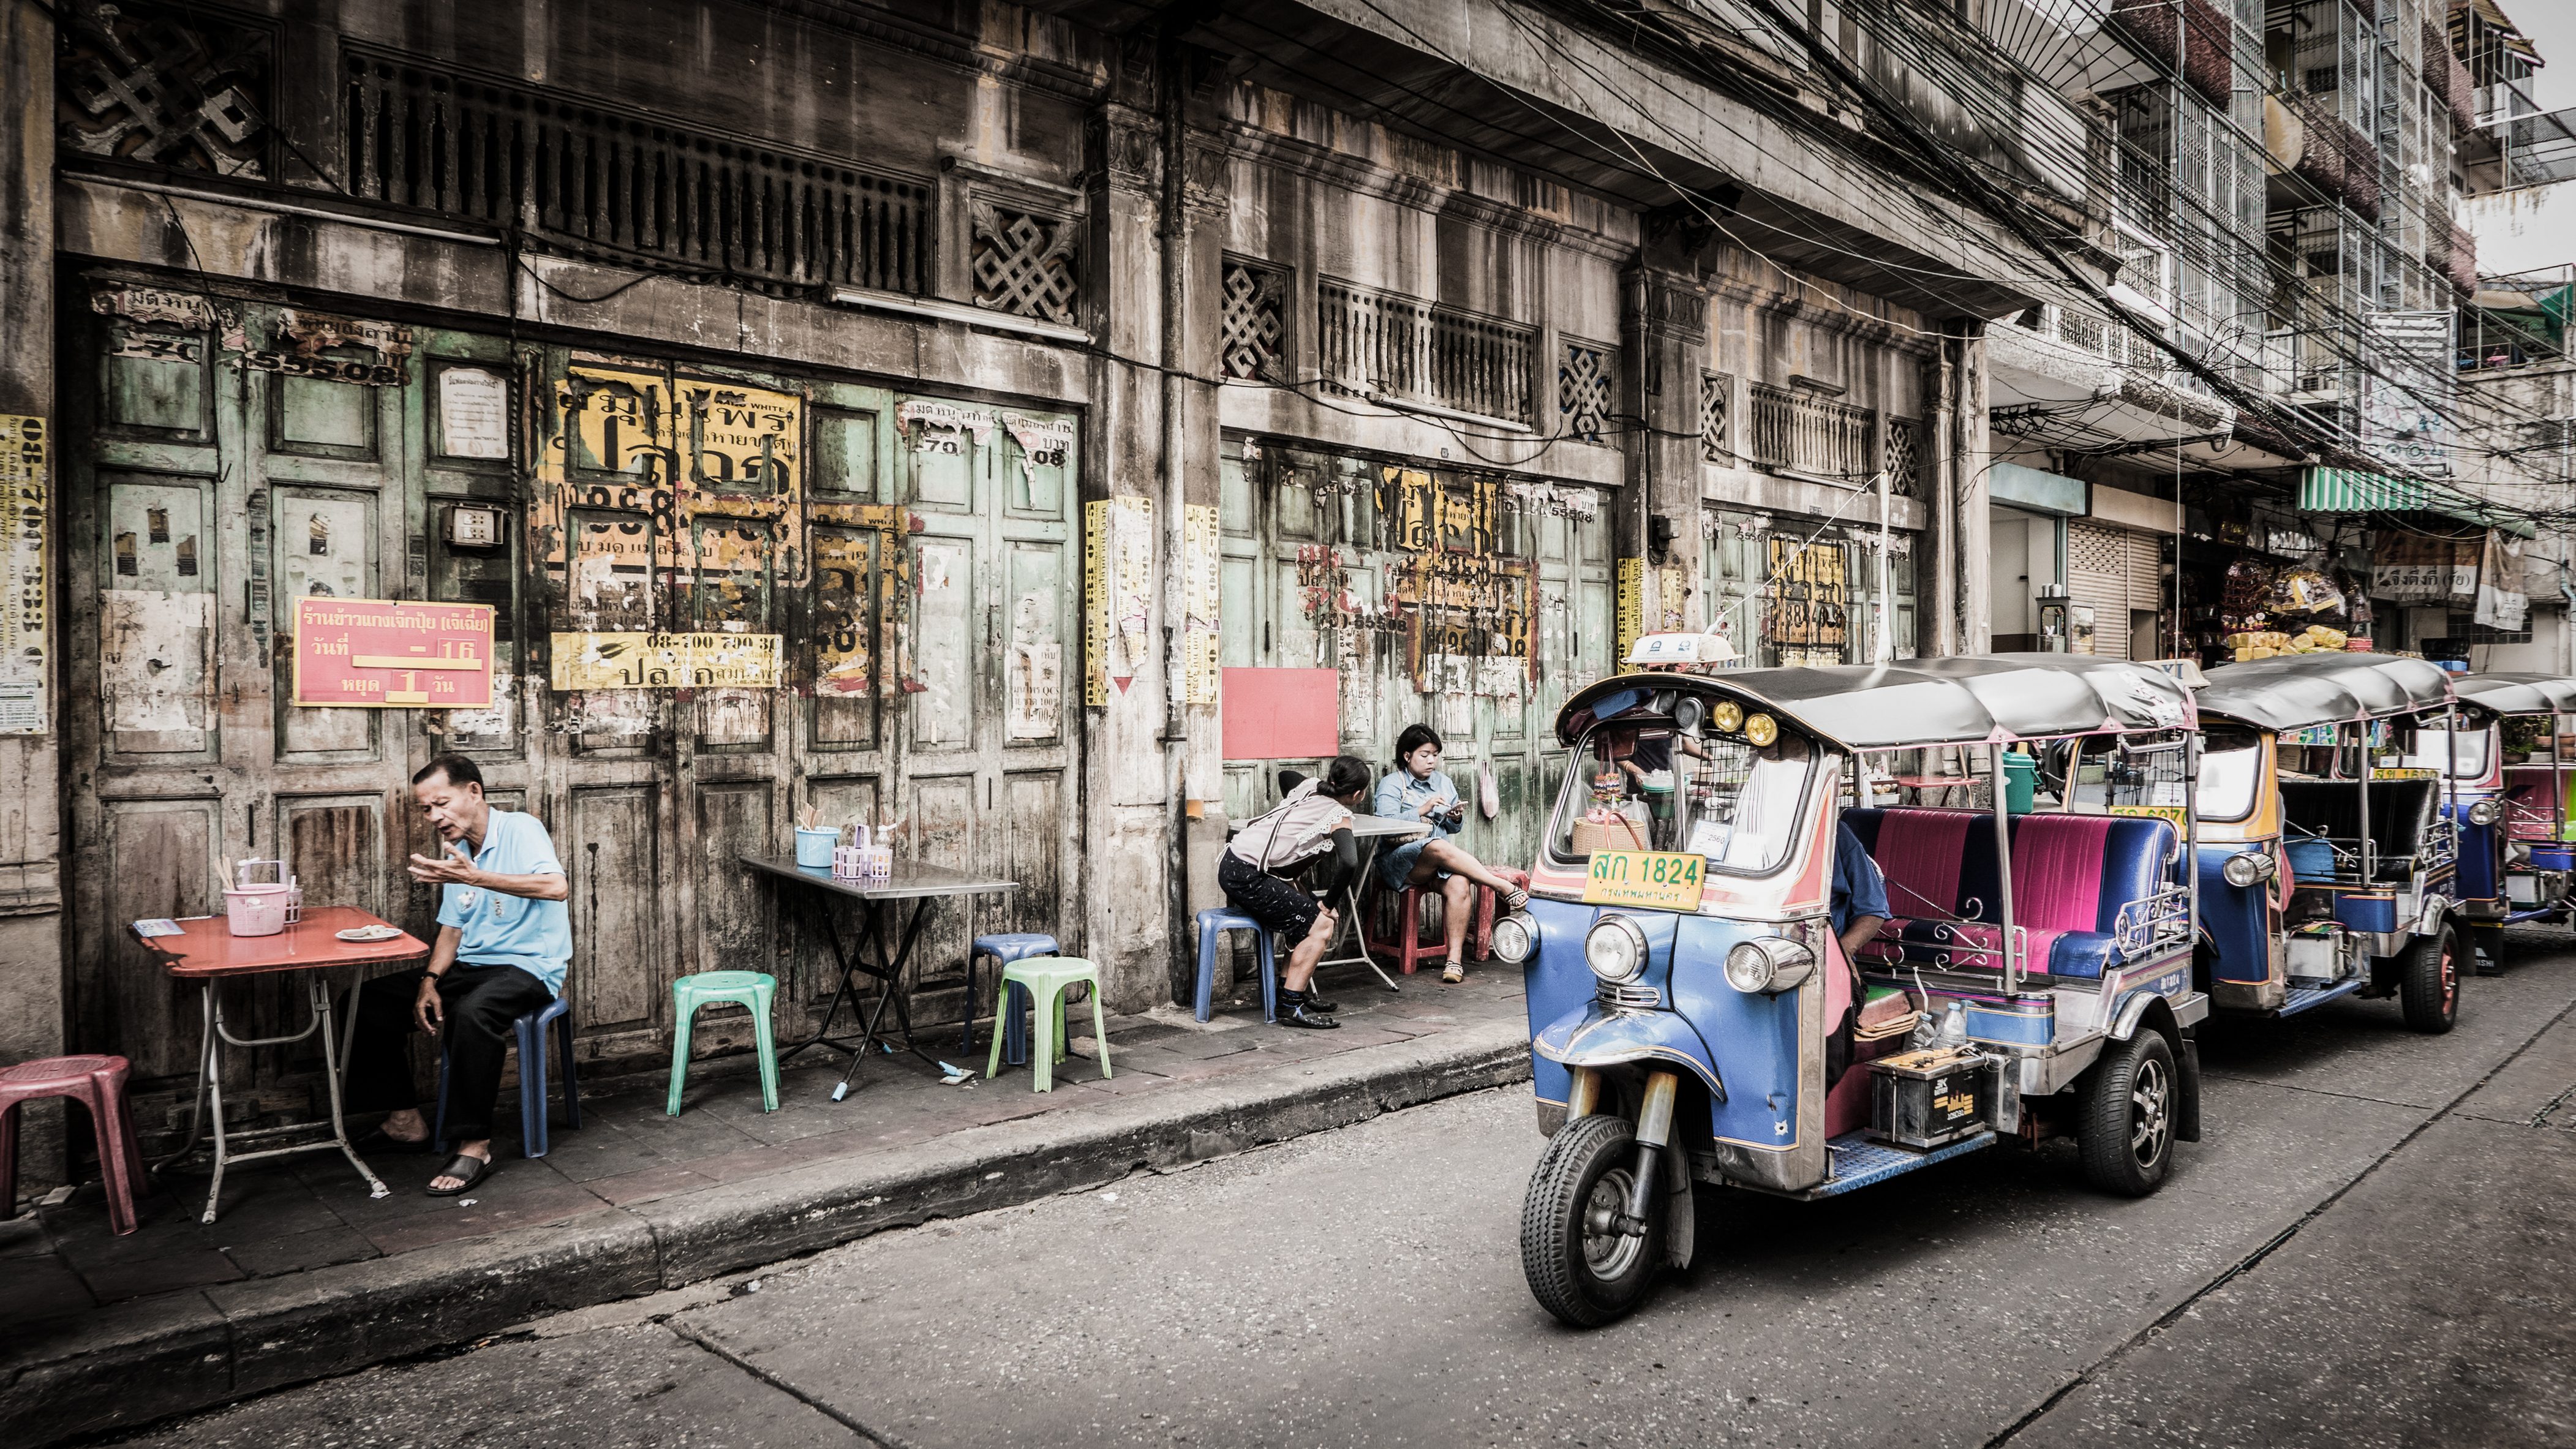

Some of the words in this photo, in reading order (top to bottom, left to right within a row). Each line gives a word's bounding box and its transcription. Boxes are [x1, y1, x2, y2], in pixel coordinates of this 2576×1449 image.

[751, 403, 785, 413] WHITE
[311, 633, 349, 656] วันที่
[442, 642, 475, 659] 16
[341, 678, 380, 697] หยุด
[432, 676, 456, 693] วัน
[1708, 834, 1726, 845] 2560
[1594, 853, 1629, 881] สก
[1642, 857, 1698, 886] 1824
[1600, 888, 1681, 902] กรุงเทพมหานคร
